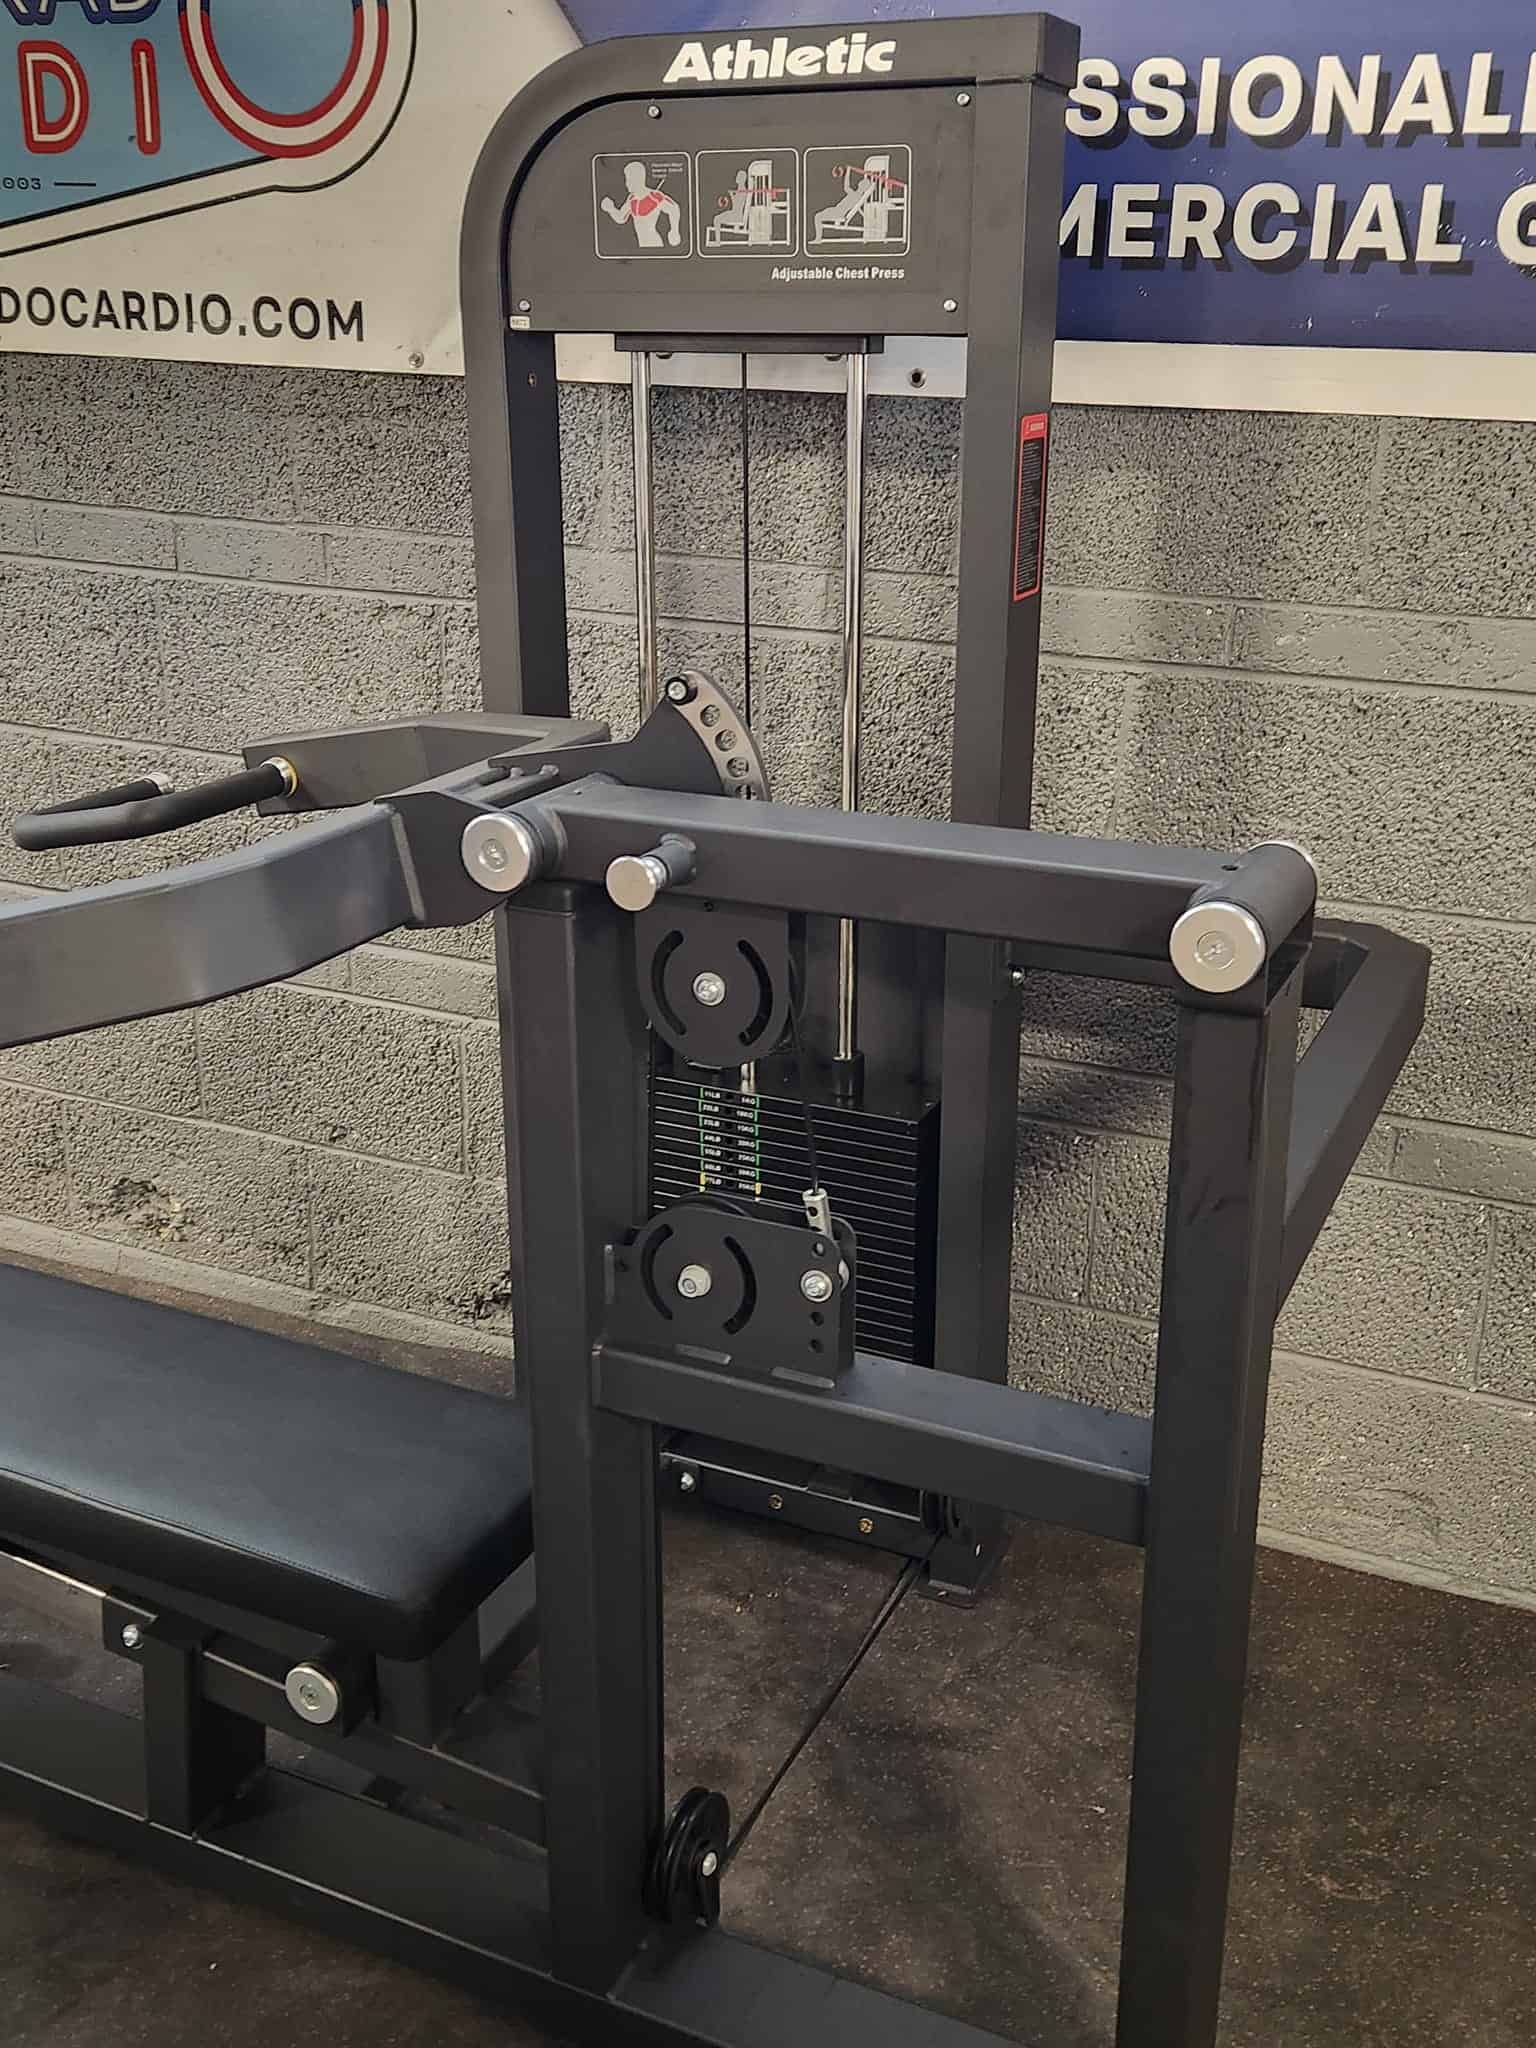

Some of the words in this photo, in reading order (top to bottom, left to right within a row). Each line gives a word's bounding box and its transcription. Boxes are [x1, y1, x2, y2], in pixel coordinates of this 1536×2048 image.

[662, 33, 897, 83] Athletic
[1065, 52, 1536, 137] SSIONAL
[771, 266, 833, 282] Adjustable
[835, 266, 869, 280] Chest
[871, 265, 905, 280] Press
